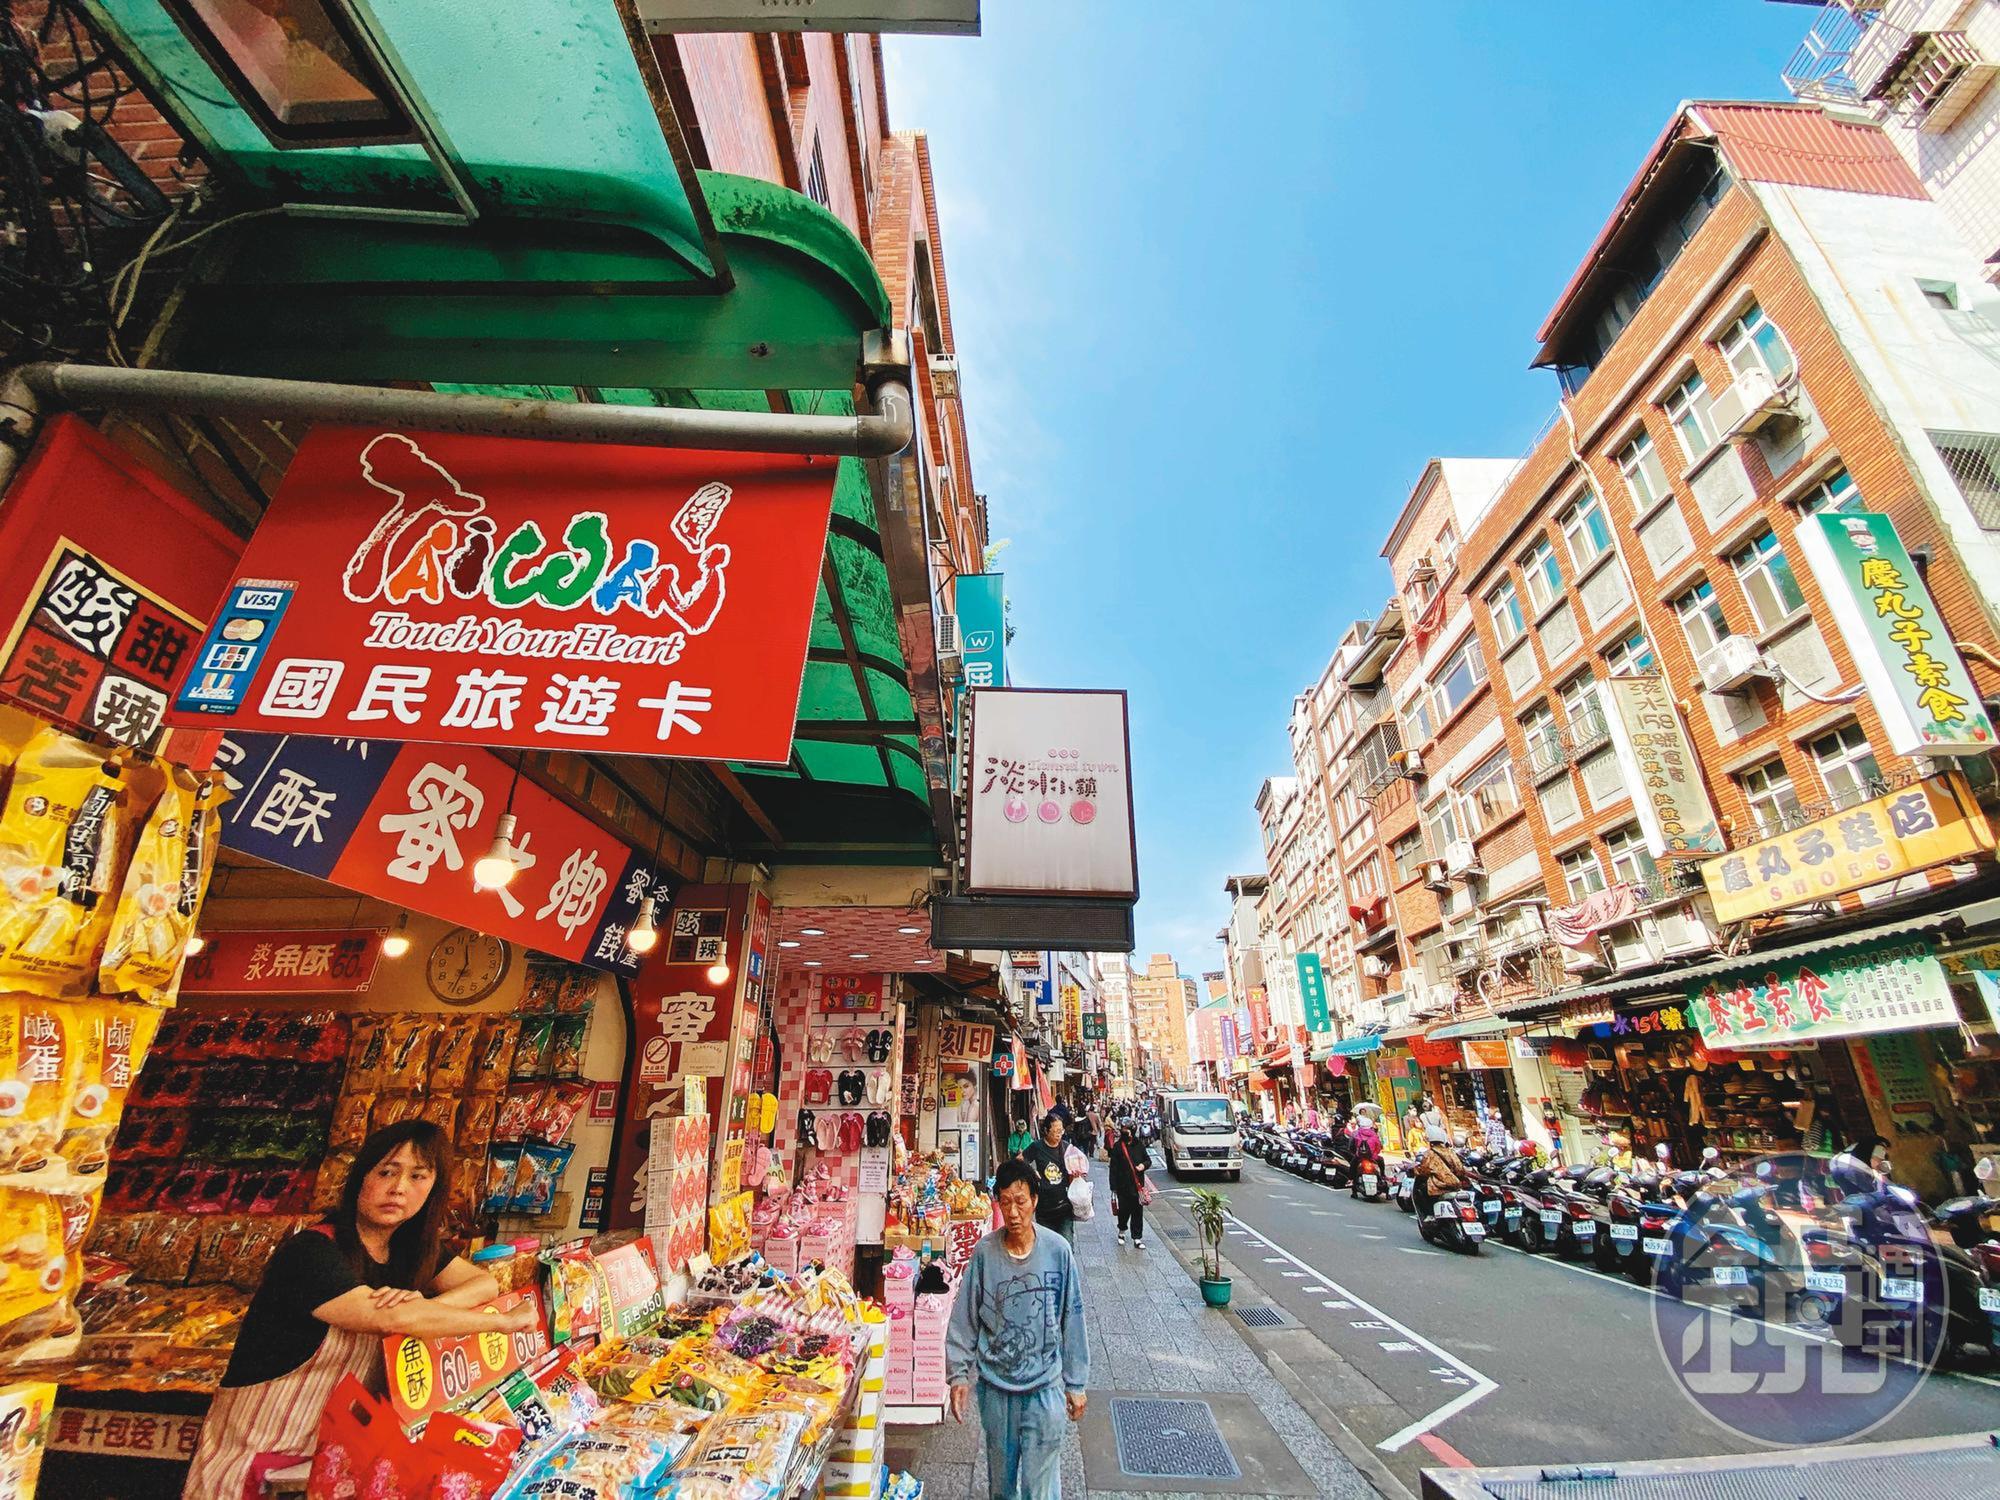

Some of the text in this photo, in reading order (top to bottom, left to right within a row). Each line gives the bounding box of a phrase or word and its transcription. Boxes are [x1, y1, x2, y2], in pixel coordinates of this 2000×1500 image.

[243, 594, 278, 607] VISA
[368, 612, 685, 665] Touch Your Heart
[1861, 558, 1967, 723] 慶丸子素食
[258, 659, 713, 741] 國民旅遊卡
[980, 756, 1098, 798] 淡水小鎮
[620, 884, 670, 969] 各式產
[266, 942, 337, 977] 魚酥
[18, 1010, 64, 1083] 鹹蛋
[941, 1023, 993, 1059] 刻印
[402, 1336, 429, 1403] 魚酥
